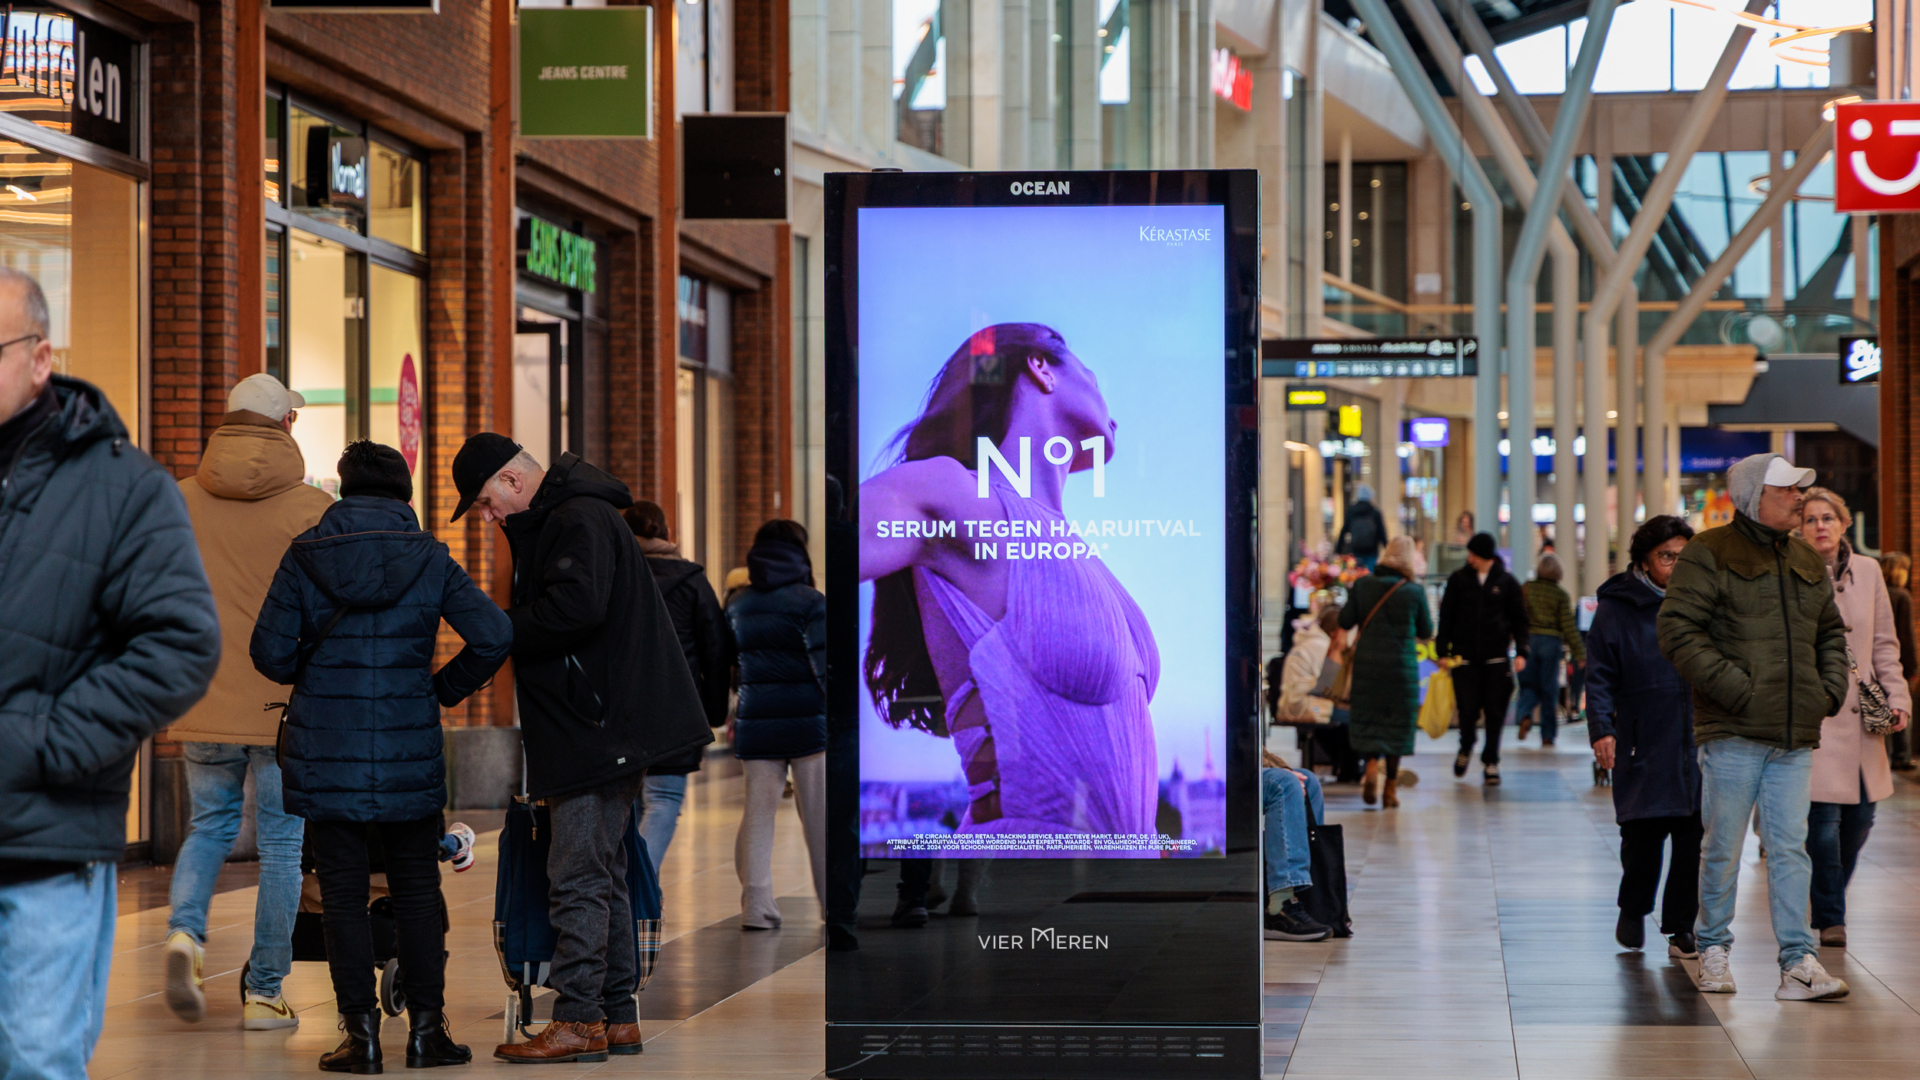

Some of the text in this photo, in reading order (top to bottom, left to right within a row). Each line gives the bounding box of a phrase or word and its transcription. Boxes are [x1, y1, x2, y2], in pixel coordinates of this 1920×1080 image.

[538, 65, 628, 80] JEANS CENTRE
[331, 141, 366, 198] Normal
[1010, 181, 1070, 196] OCEAN
[1140, 226, 1212, 242] KÉRASTASE
[876, 519, 1202, 538] SERUM TEGEN HAARUITVAL
[974, 542, 998, 560] IN
[977, 927, 1109, 950] VIER MEREN
